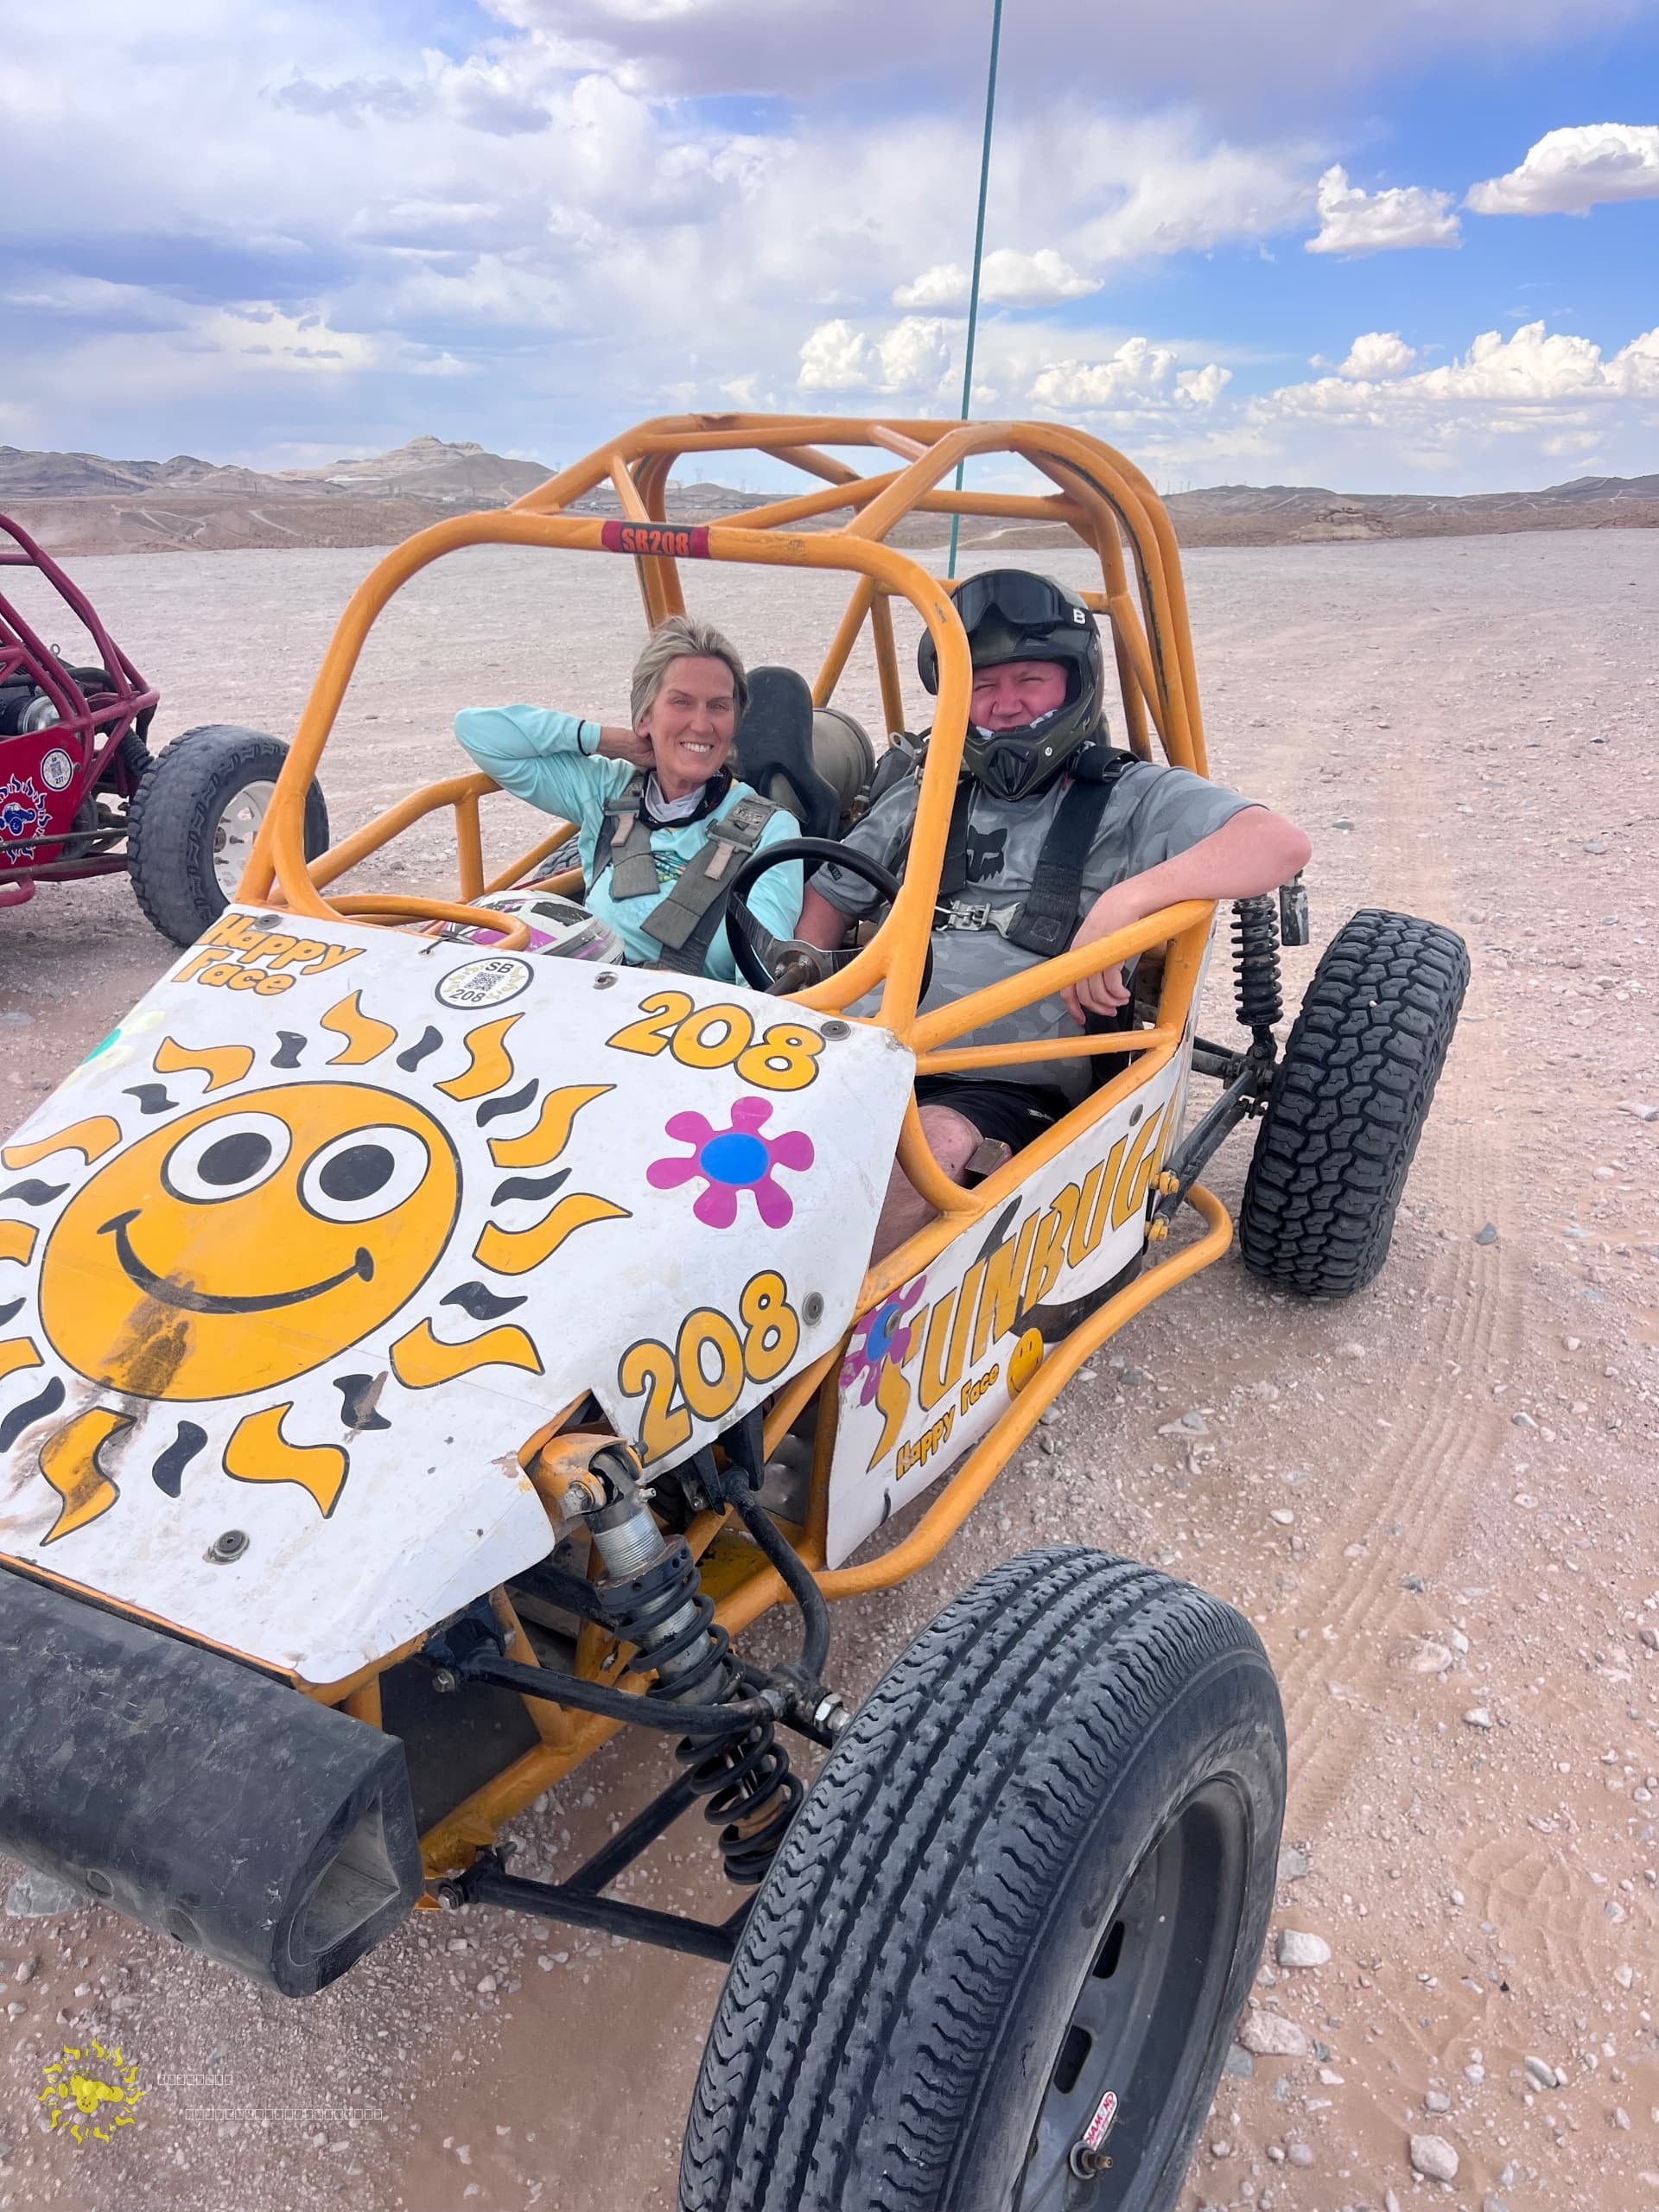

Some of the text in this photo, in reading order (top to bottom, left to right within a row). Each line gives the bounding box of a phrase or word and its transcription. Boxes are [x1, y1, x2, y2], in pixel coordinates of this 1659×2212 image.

[622, 528, 690, 556] SB208
[170, 947, 296, 995] Face
[193, 912, 367, 976] Happy
[485, 962, 514, 973] SB
[448, 988, 486, 1002] 208
[605, 990, 827, 1092] 208
[617, 1269, 800, 1468] 208
[896, 1363, 1000, 1481] Happy Face
